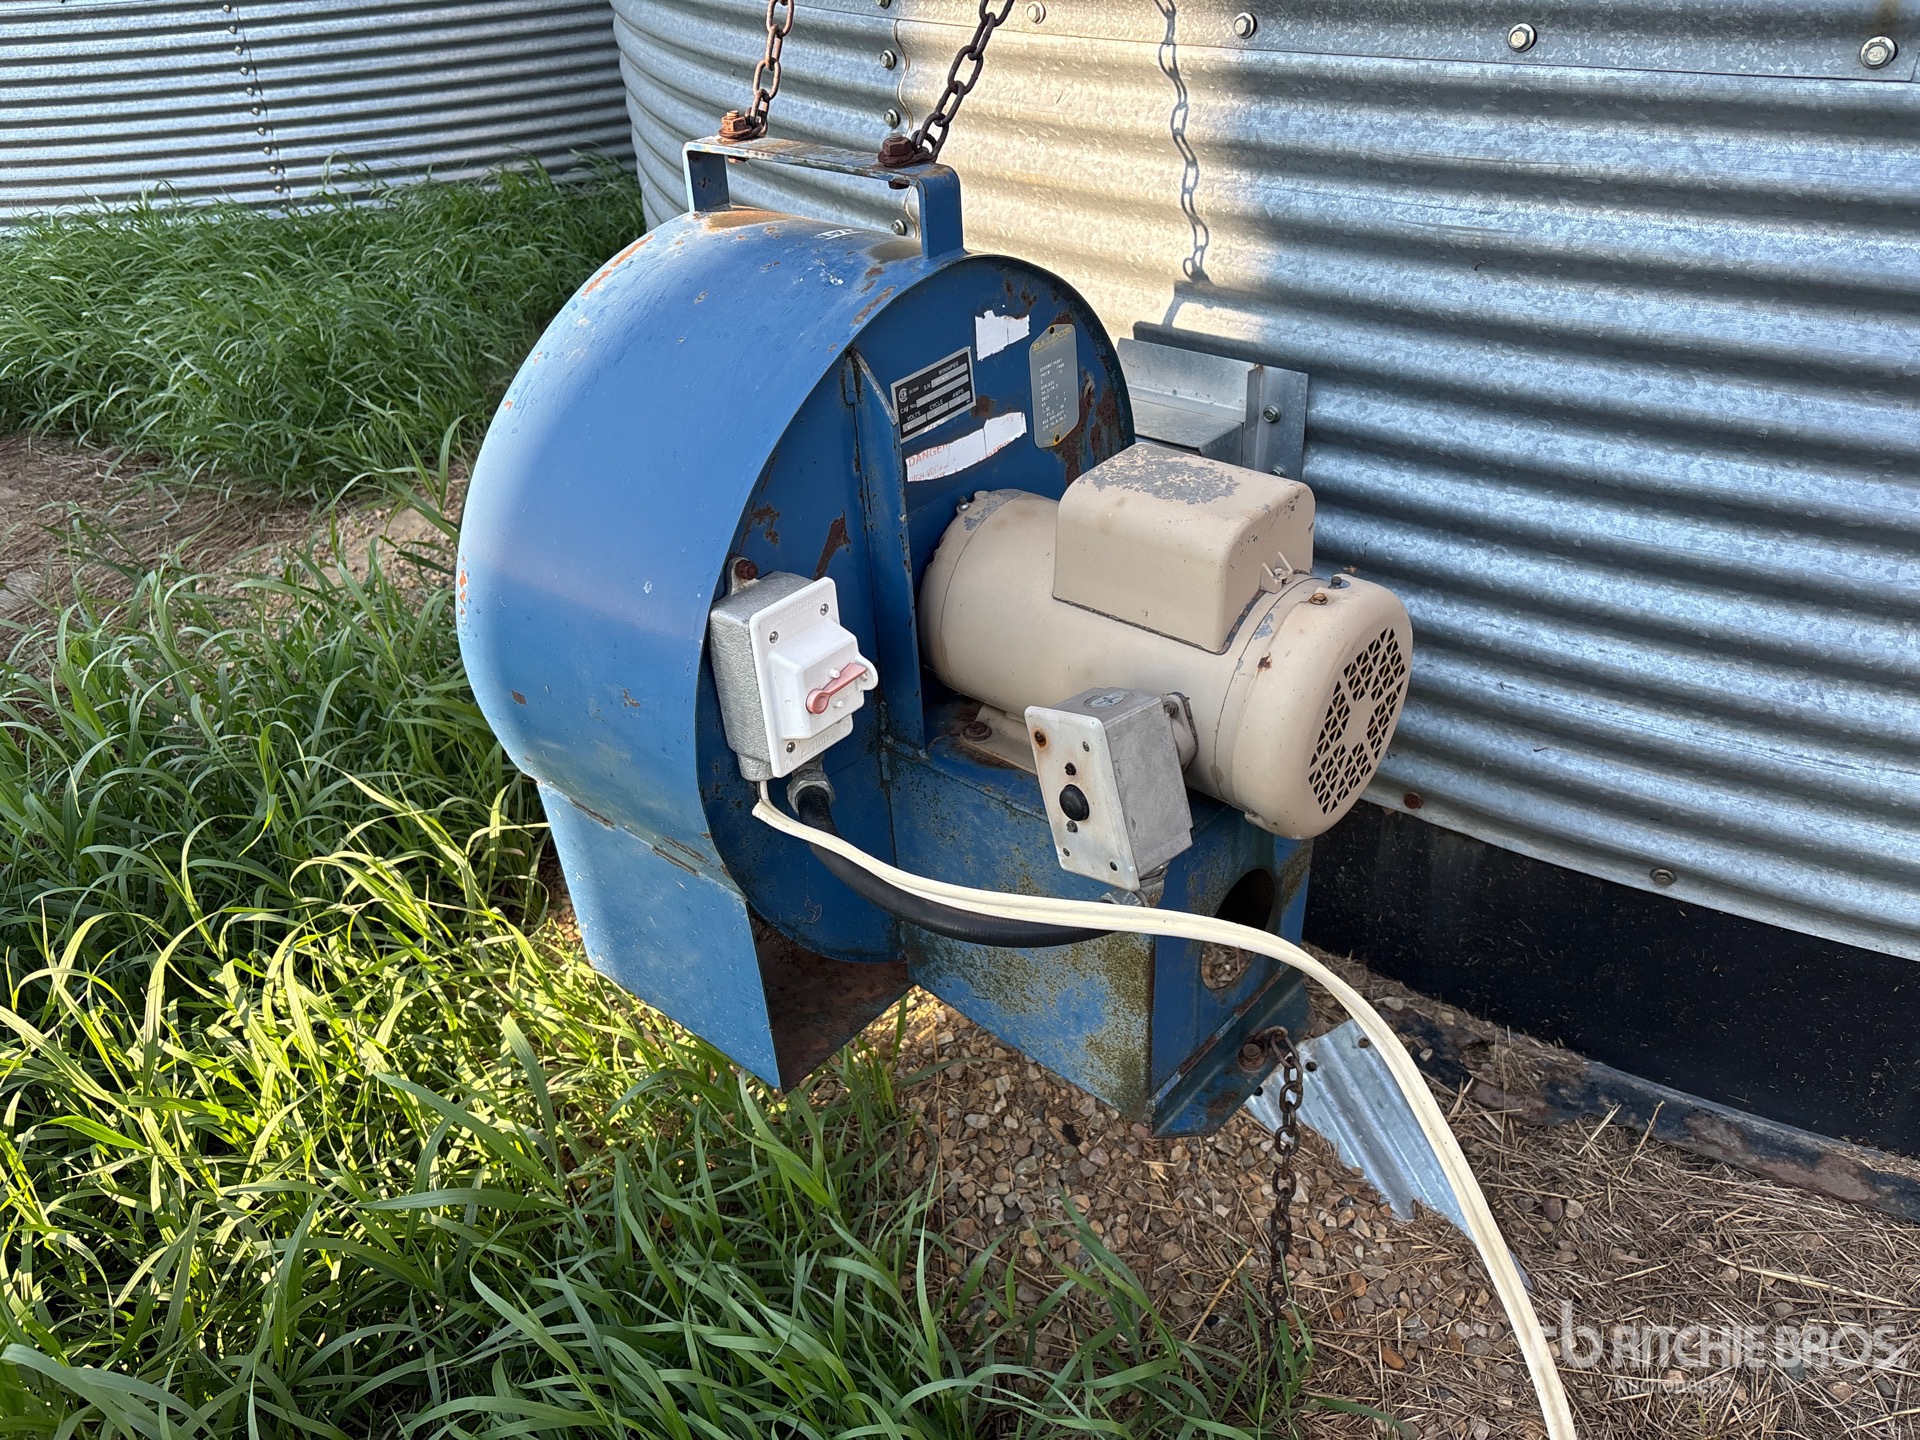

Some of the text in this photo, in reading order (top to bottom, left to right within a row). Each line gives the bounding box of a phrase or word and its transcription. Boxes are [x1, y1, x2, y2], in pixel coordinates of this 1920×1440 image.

[952, 388, 964, 398] AMPS
[930, 398, 943, 410] CYCLE
[907, 411, 921, 421] VOLTS
